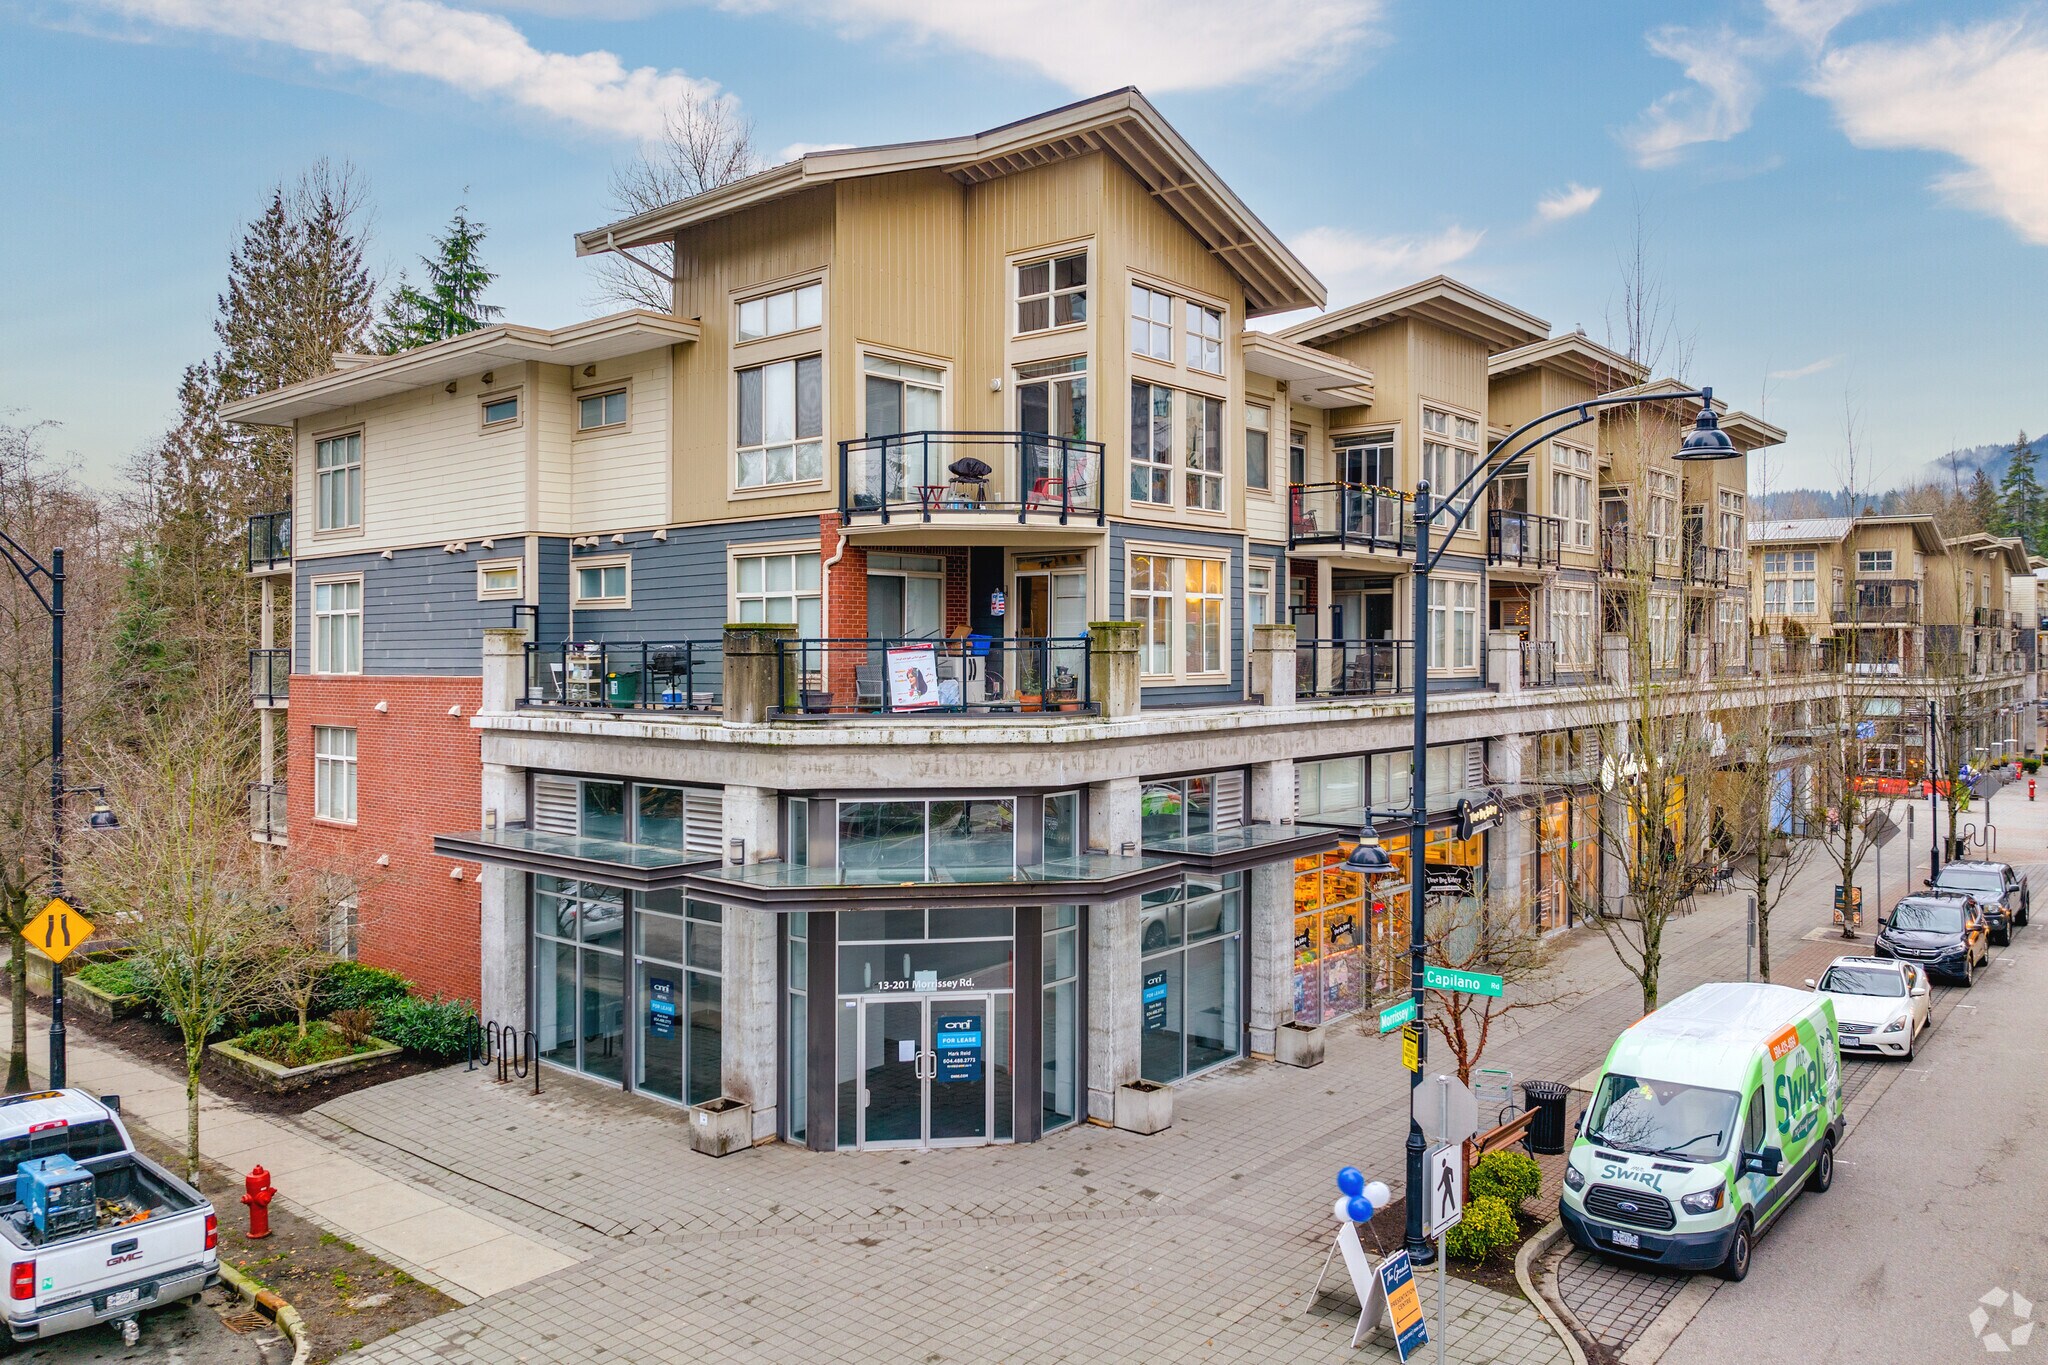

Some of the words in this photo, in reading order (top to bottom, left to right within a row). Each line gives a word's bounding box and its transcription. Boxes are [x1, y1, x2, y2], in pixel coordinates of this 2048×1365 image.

[878, 981, 909, 990] 13-201
[912, 979, 958, 989] Morrissey
[960, 978, 974, 987] Rd.
[1427, 971, 1480, 990] Capilano
[1491, 982, 1500, 990] Rd
[1381, 1007, 1409, 1028] Morrissey
[1601, 1165, 1662, 1193] SWIRL
[106, 1251, 143, 1267] GMC
[1390, 1287, 1416, 1308] PRESENTATION
[1397, 1297, 1412, 1311] CENTRE
